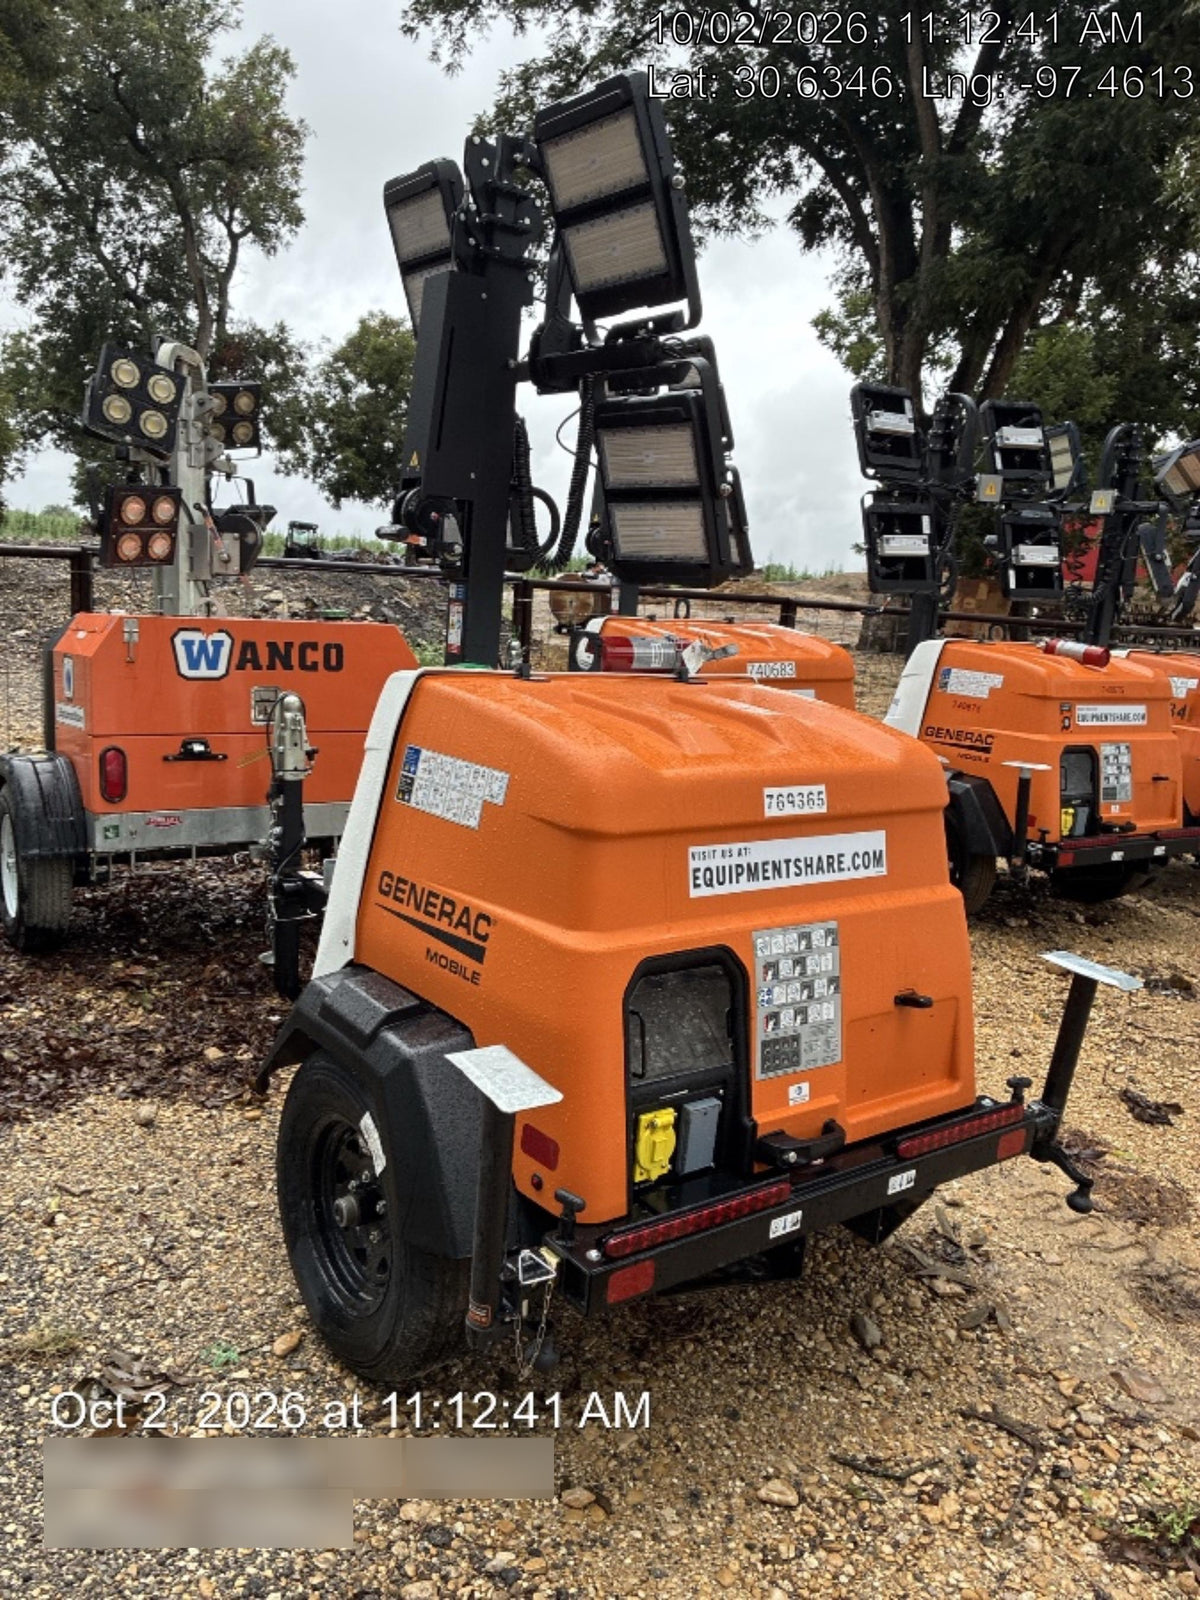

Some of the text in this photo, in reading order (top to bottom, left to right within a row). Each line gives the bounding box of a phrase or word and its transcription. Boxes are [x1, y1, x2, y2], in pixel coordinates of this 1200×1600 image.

[178, 637, 345, 673] WANCO
[749, 663, 795, 678] 740683
[925, 726, 994, 745] GENERAC
[766, 791, 825, 811] 769365
[691, 846, 751, 861] VISIT US AT:
[692, 849, 884, 889] EQUIPMENTSHARE.COM
[378, 870, 492, 943] GENERAC
[426, 947, 482, 986] MOBILE
